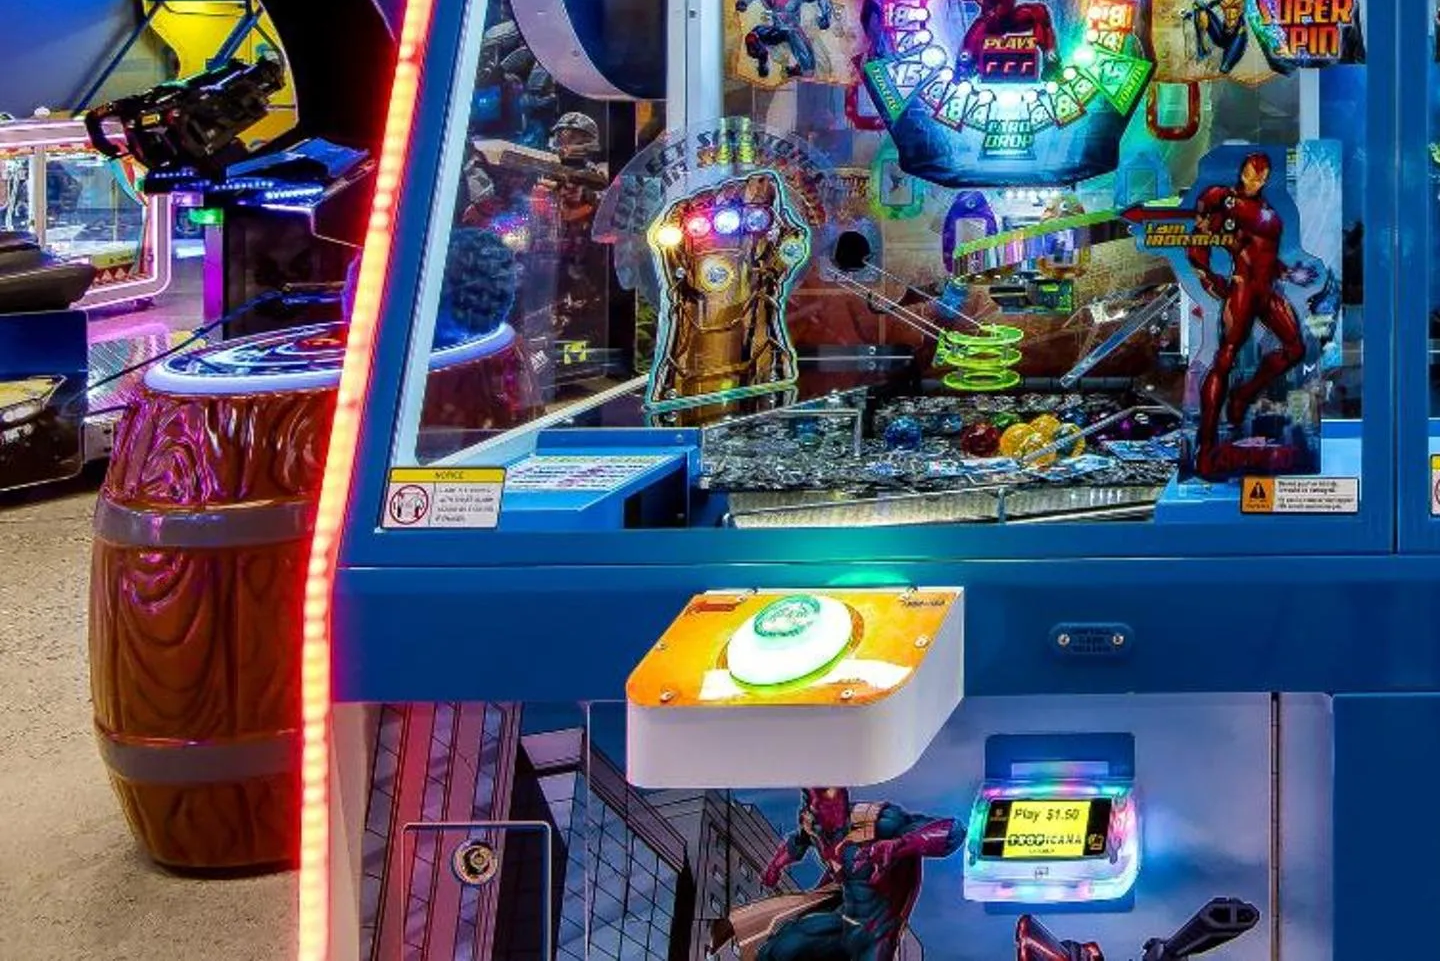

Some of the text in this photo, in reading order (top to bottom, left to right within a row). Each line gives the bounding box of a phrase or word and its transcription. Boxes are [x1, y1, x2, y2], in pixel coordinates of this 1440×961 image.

[985, 134, 1032, 148] DROP
[1146, 234, 1234, 246] IRON MAN
[1014, 808, 1080, 824] Play $1.50
